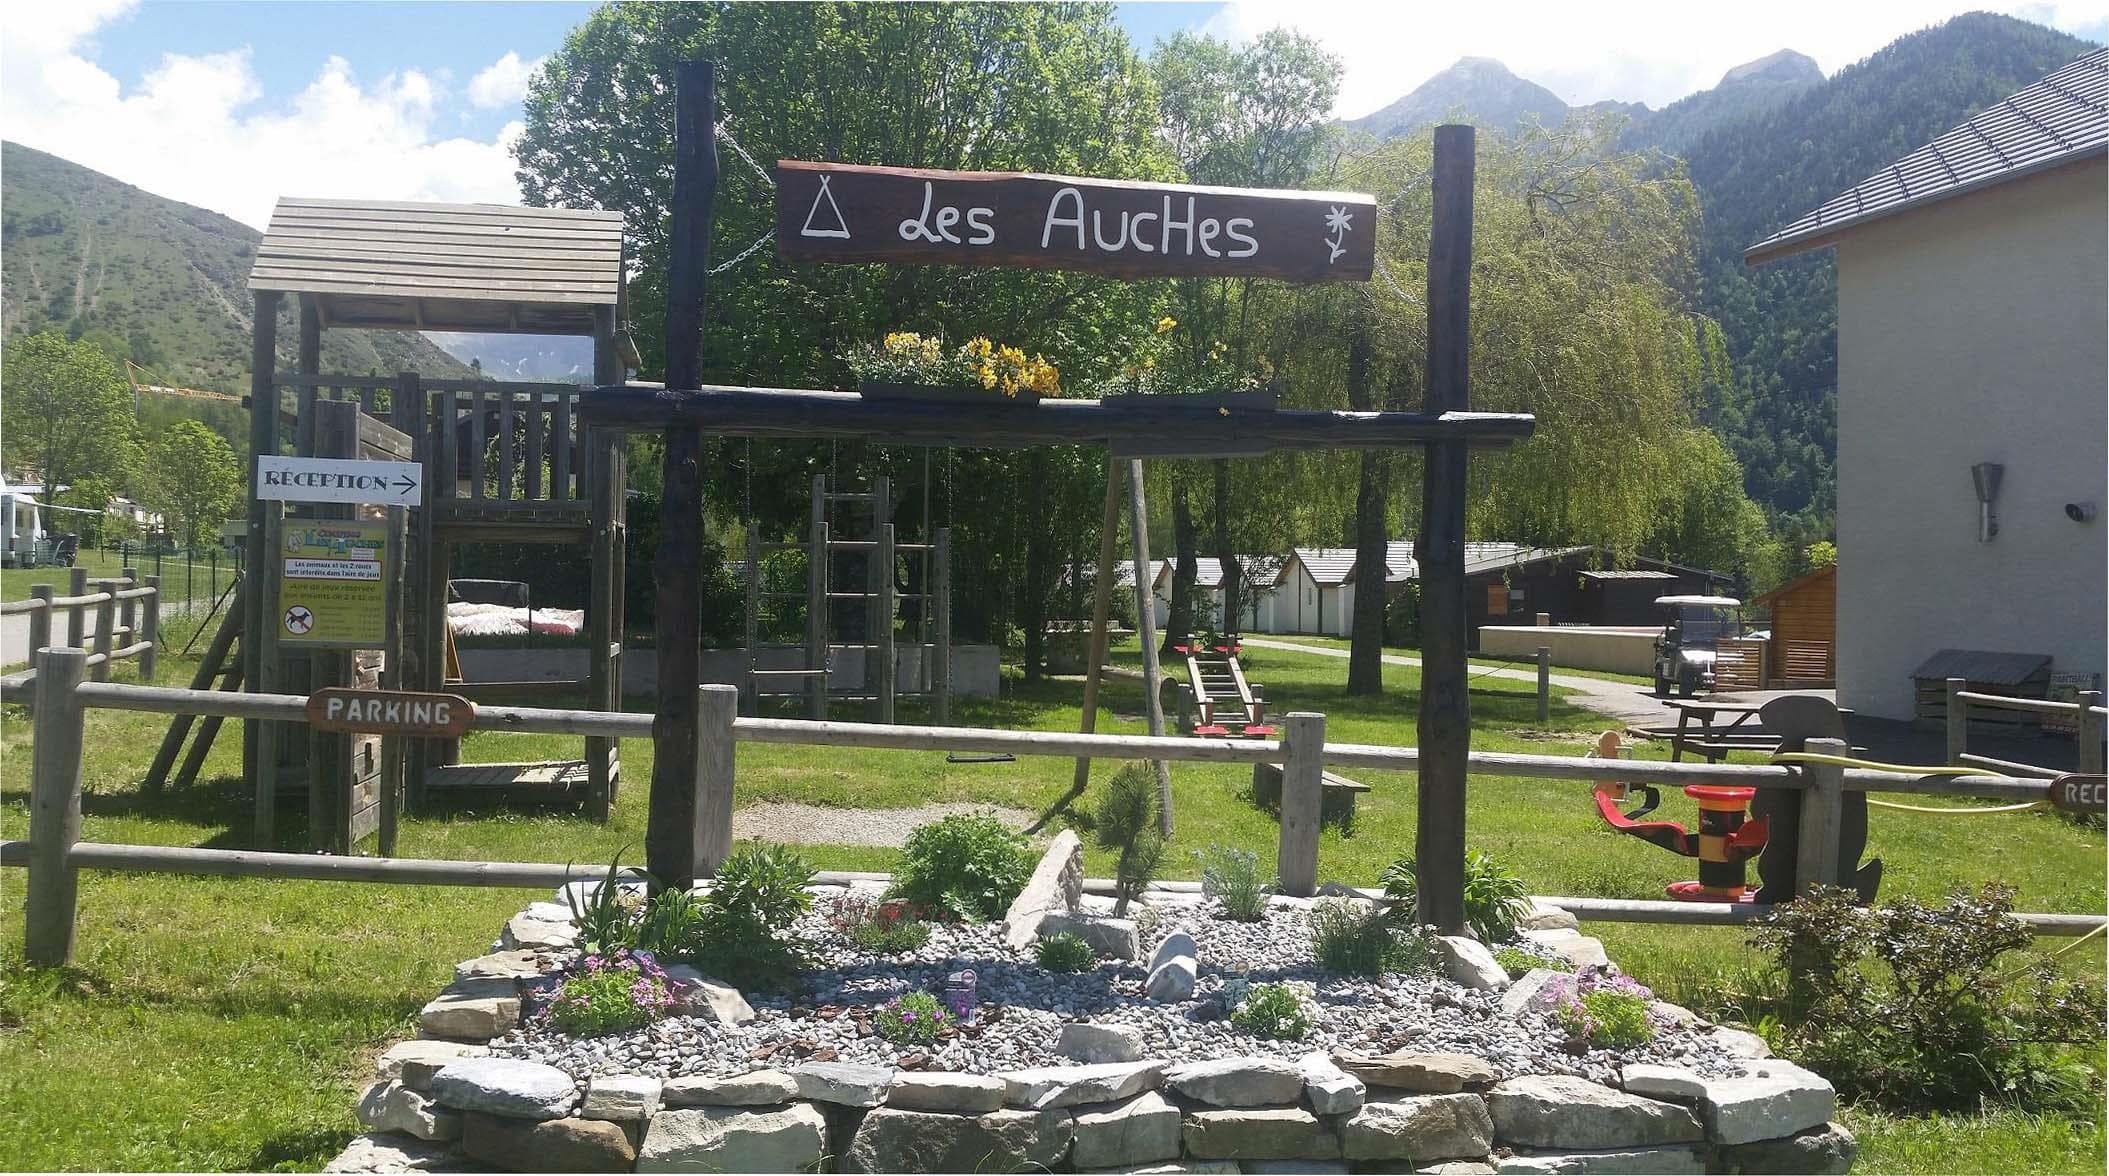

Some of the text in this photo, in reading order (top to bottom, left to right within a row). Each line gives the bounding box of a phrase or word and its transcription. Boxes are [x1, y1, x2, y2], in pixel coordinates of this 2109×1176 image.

[900, 181, 995, 245] Les
[295, 560, 305, 568] Les
[366, 571, 380, 579] jeux
[327, 697, 450, 725] PARKING
[2065, 782, 2107, 803] REC
